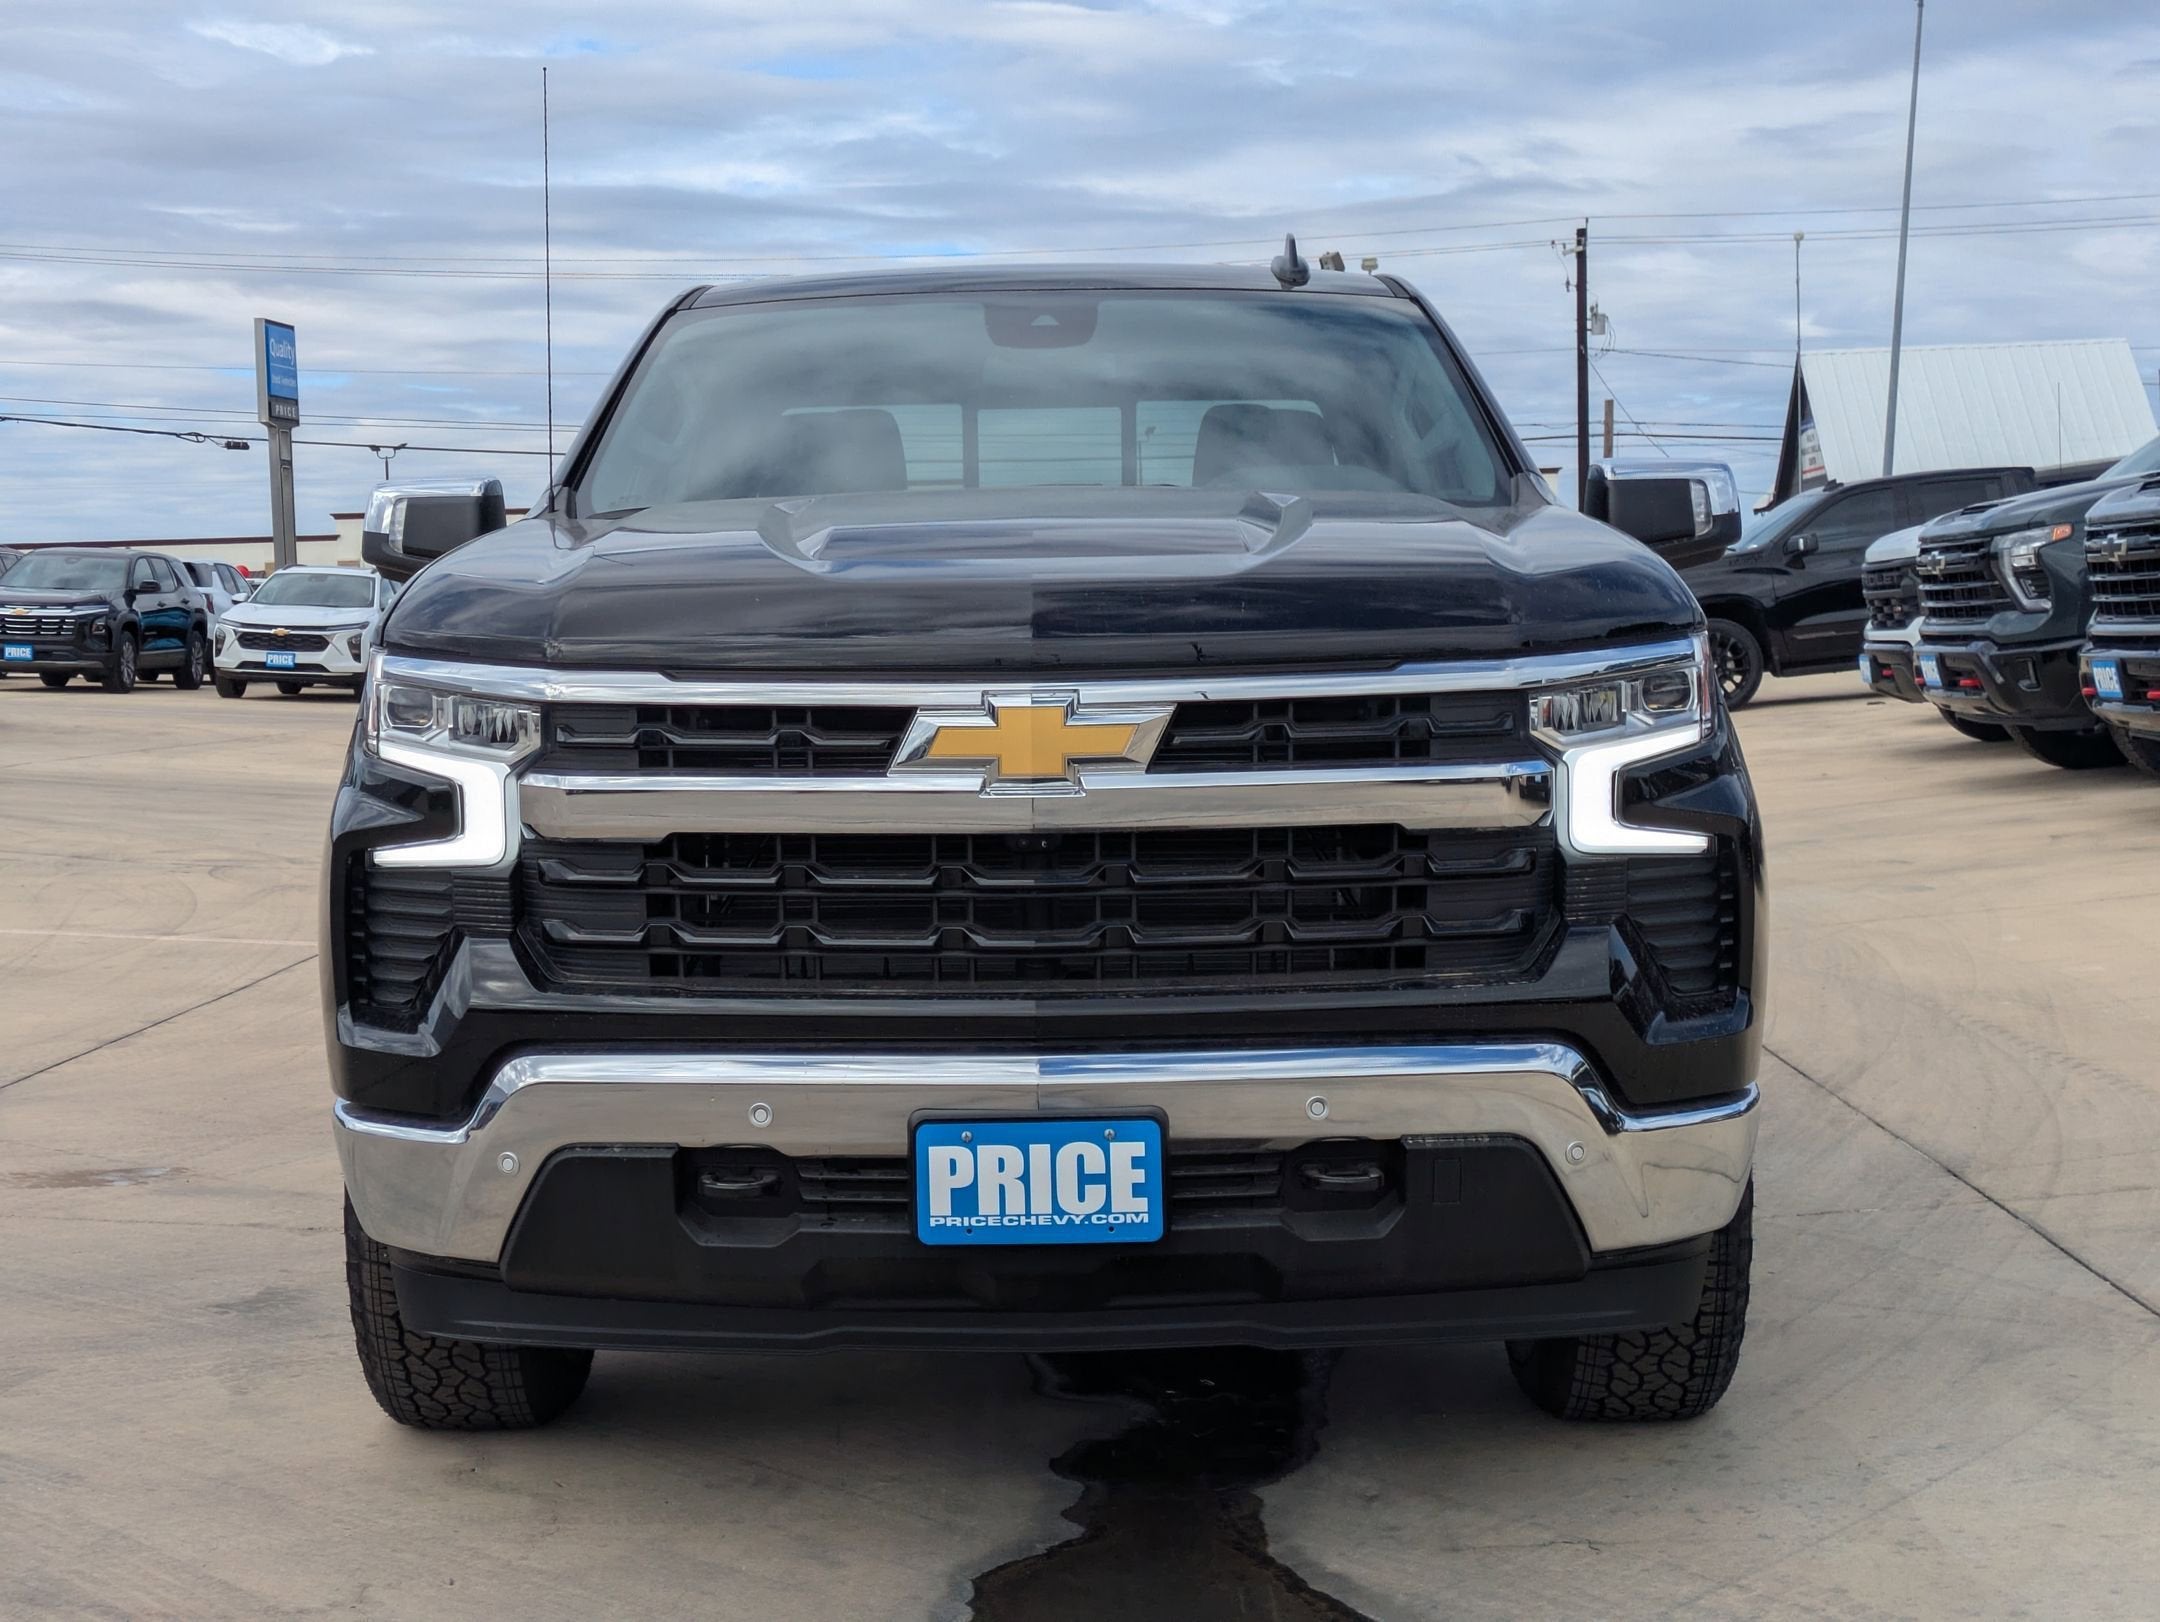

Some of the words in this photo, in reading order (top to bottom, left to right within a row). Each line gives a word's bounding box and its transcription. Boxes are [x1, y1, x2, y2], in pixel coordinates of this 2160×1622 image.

[270, 338, 295, 366] Quality
[275, 404, 296, 417] PRICE
[5, 647, 32, 658] PRICE
[267, 654, 294, 665] PRICE
[928, 1141, 1149, 1216] PRICE
[929, 1213, 1149, 1227] PRICECHEVY.COM
